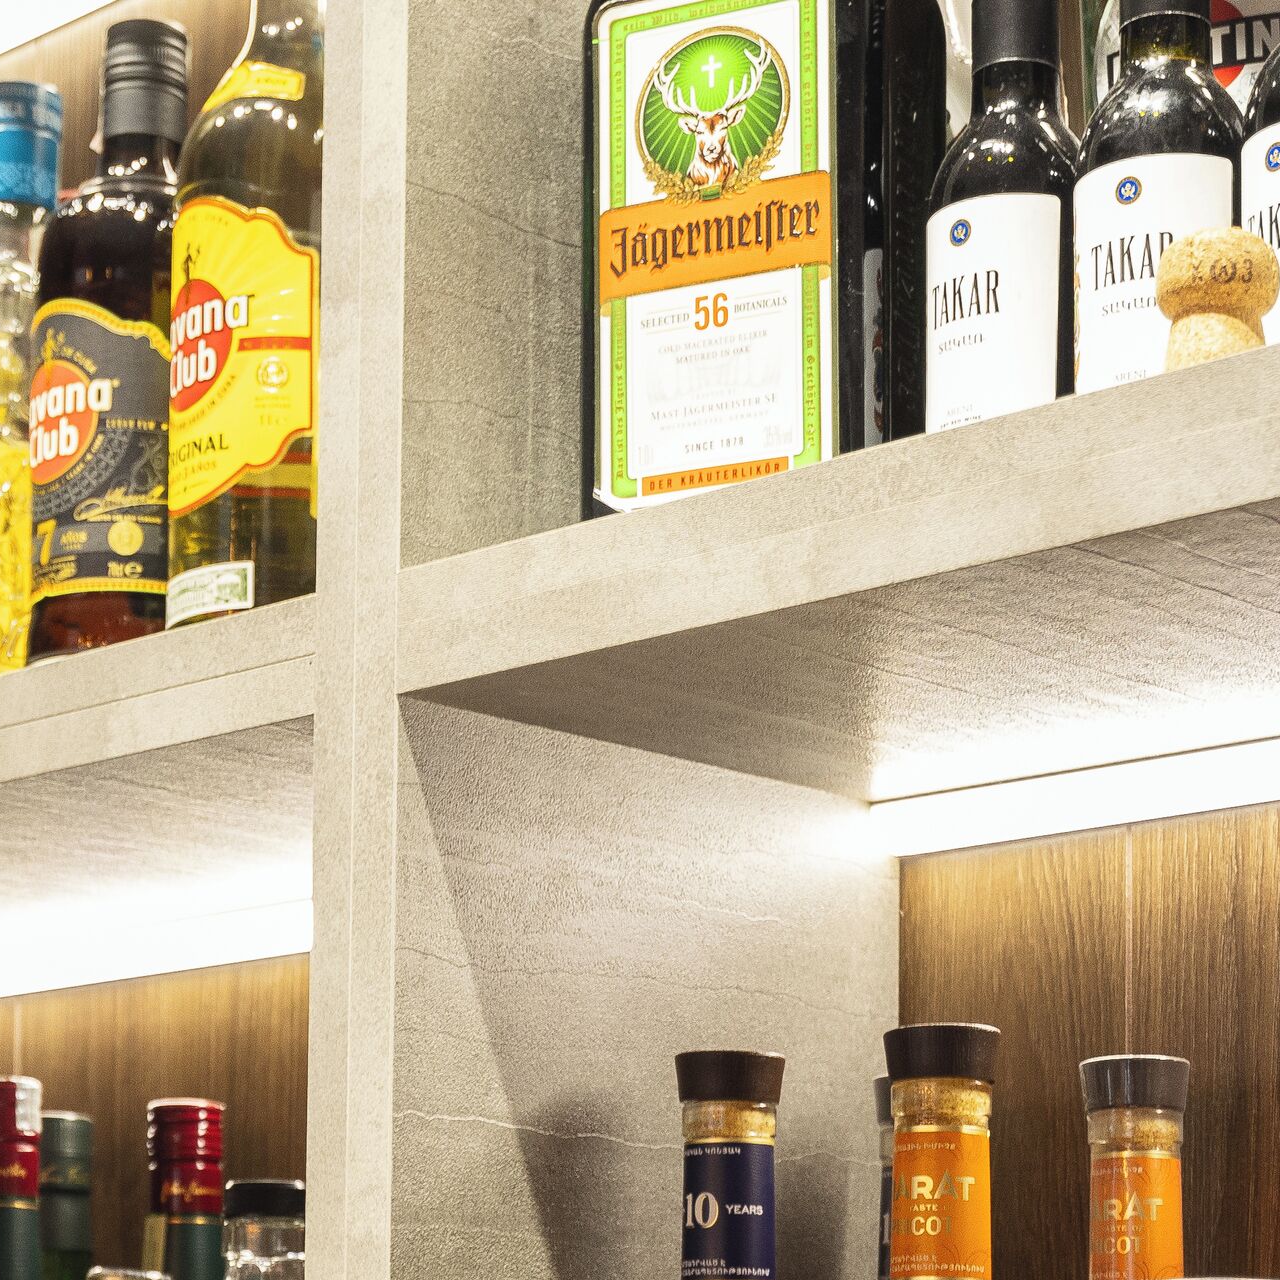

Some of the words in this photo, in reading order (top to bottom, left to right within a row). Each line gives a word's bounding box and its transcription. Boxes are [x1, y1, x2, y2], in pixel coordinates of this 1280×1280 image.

[640, 312, 690, 329] SELECTED
[694, 292, 729, 331] 56
[734, 296, 788, 314] BOTANICALS
[932, 270, 1000, 331] TAKAR
[170, 295, 249, 353] avana
[170, 338, 217, 398] Club
[29, 378, 113, 429] avana
[169, 433, 229, 468] RIGINAL
[685, 440, 714, 454] SINCE
[721, 436, 744, 449] 1878
[649, 478, 673, 492] DER
[680, 463, 781, 487] KRÄUTERLIKÖR
[36, 518, 57, 566] 7
[685, 1191, 719, 1229] 10
[725, 1203, 764, 1216] YEARS
